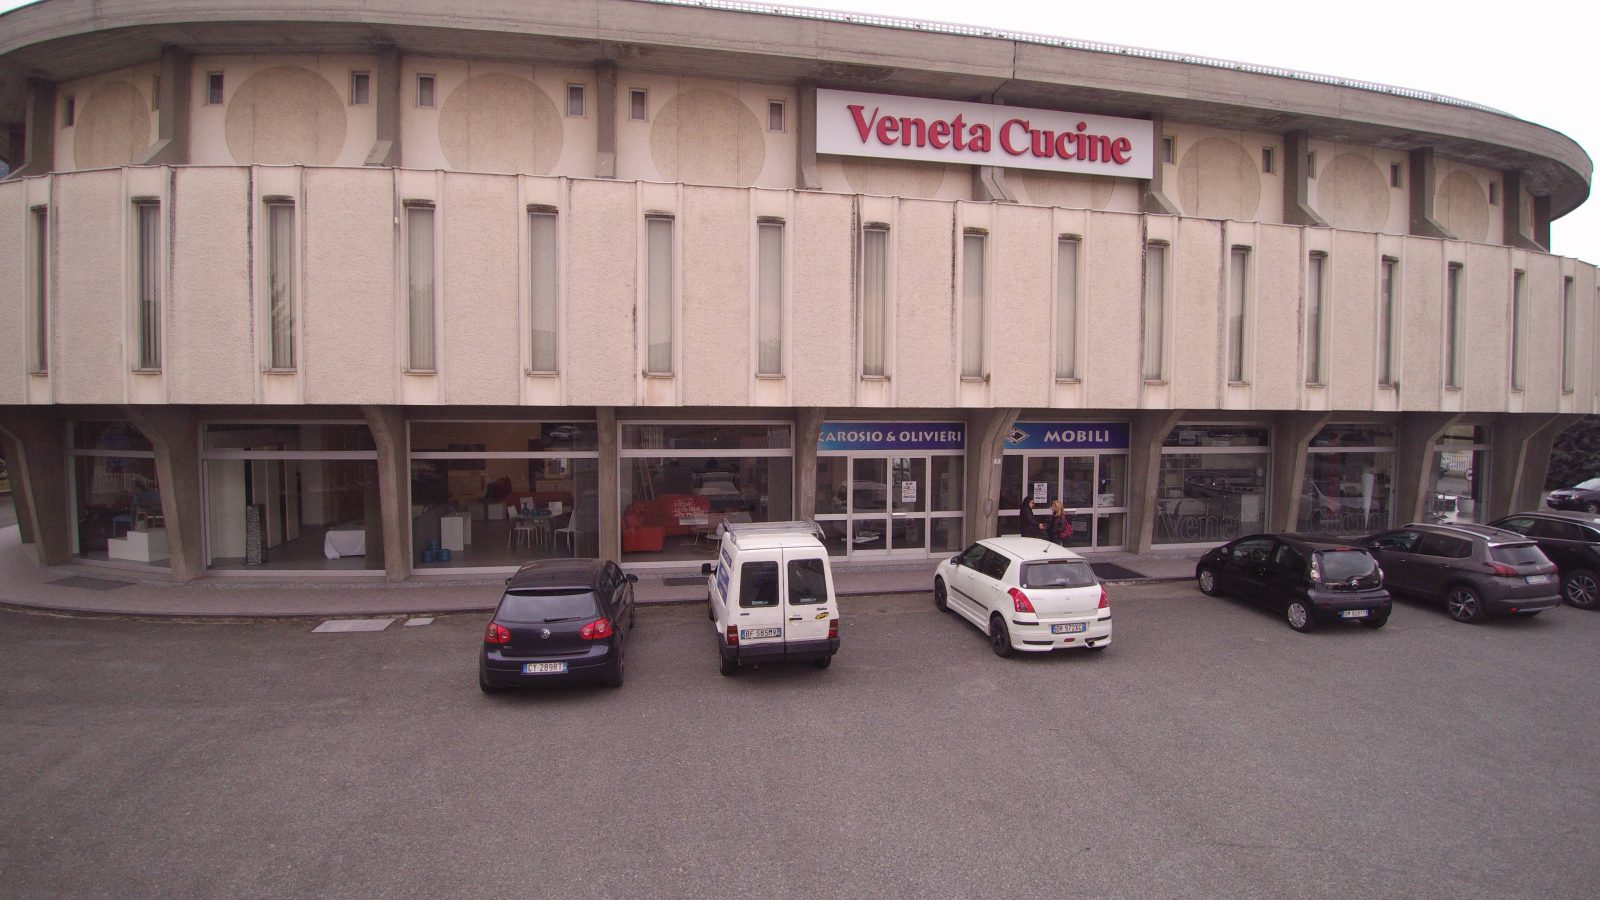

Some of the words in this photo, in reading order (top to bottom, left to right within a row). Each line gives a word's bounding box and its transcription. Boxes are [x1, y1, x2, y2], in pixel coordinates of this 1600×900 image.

[846, 104, 992, 153] Veneta
[999, 118, 1132, 165] Cucine
[817, 431, 883, 442] CAROSIO
[886, 431, 896, 442] &
[899, 431, 961, 442] OLIVIERI
[1043, 430, 1110, 442] MOBILI
[1159, 511, 1246, 542] Vene
